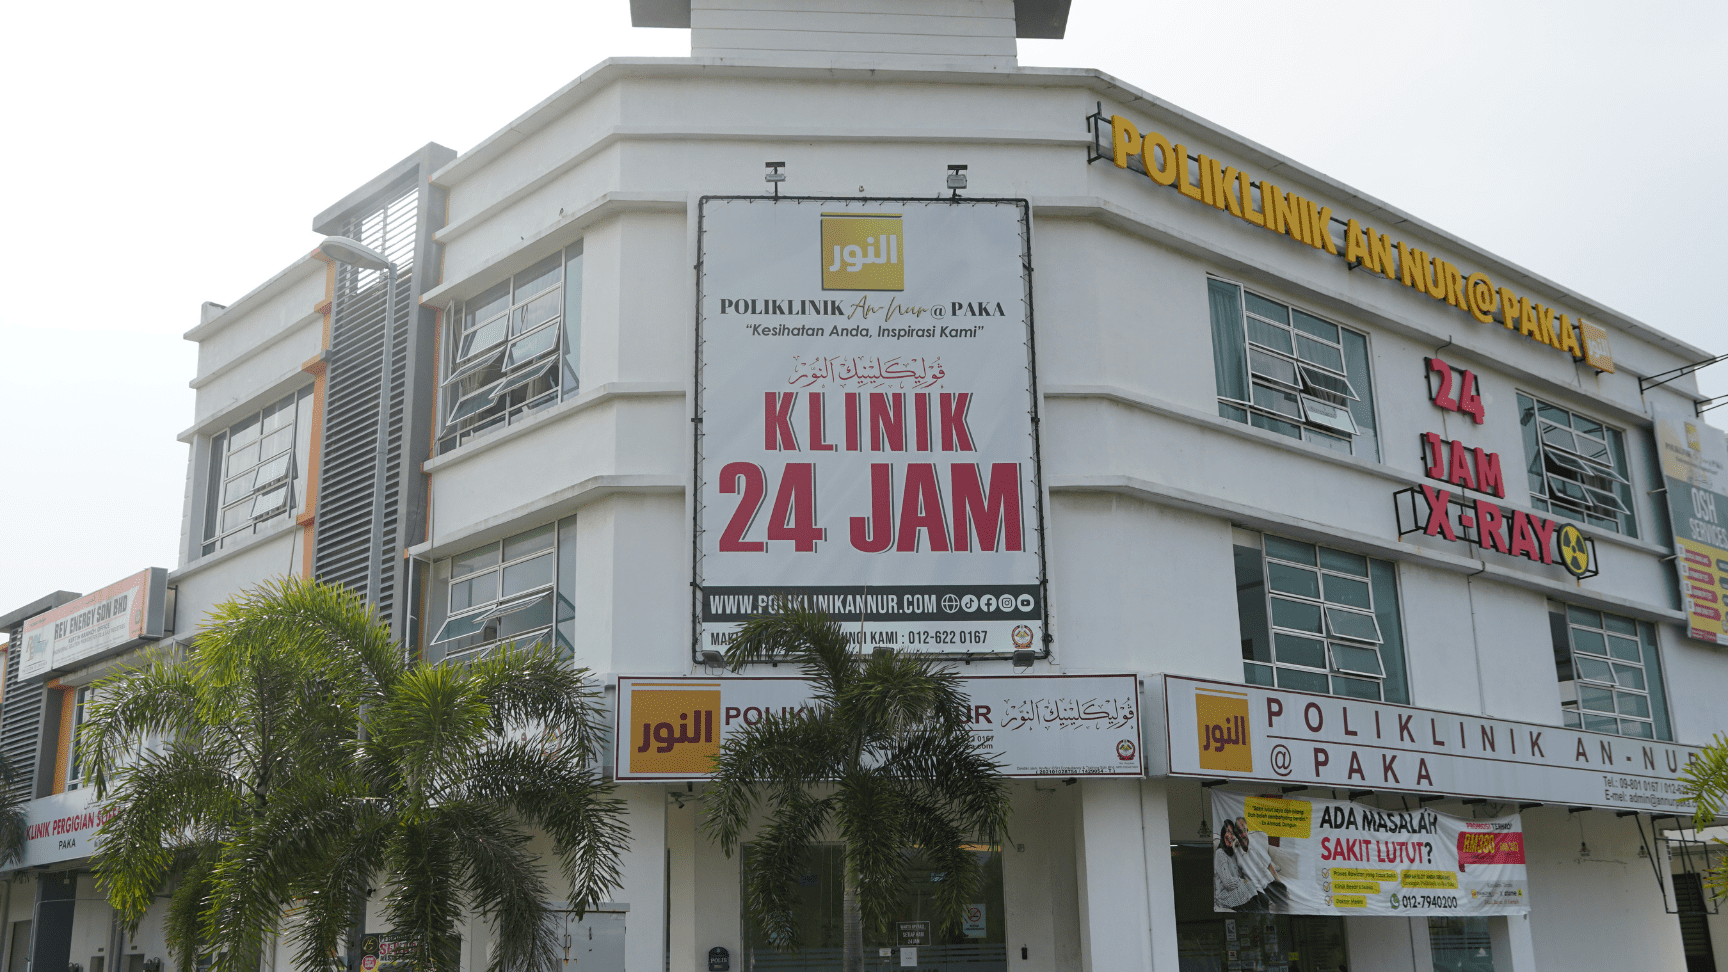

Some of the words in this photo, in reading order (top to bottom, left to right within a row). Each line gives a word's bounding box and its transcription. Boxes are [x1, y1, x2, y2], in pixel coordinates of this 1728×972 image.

[1111, 115, 1338, 256] POLIKLINIK
[1345, 218, 1395, 280] AN
[829, 234, 897, 272] النور
[719, 298, 845, 317] POLIKLINIK
[847, 294, 930, 322] An-Nur
[950, 301, 1006, 317] PAKA
[828, 325, 873, 339] Anda,
[877, 325, 936, 341] Inspirasi
[1429, 358, 1485, 425] 24
[764, 391, 977, 452] KLINIK
[1426, 432, 1505, 499] JAM
[718, 461, 828, 553] 24
[849, 462, 1026, 554] JAM
[1419, 484, 1556, 565] X-RAY
[1691, 487, 1718, 525] OSH
[54, 619, 68, 640] REV
[69, 607, 96, 635] ENERGY
[96, 601, 112, 623] SDN
[113, 595, 128, 616] BHD
[870, 631, 898, 645] KAMI
[908, 630, 956, 645] 012-622
[959, 630, 988, 645] 0167
[637, 709, 713, 754] النور
[1203, 715, 1247, 753] النور
[1266, 697, 1545, 758] POLIKLINIK
[1270, 744, 1293, 777] @
[1313, 747, 1434, 787] PAKA
[1619, 778, 1641, 791] 09-801
[1643, 780, 1659, 792] 0167
[26, 821, 51, 841] KLINIK
[52, 811, 95, 836] PERGIGIAN
[1319, 806, 1359, 831] ADA
[1362, 809, 1437, 835] MASALAH
[58, 838, 76, 850] PAKA
[1321, 836, 1372, 863] SAKIT
[1376, 840, 1433, 865] LUTUT?
[1402, 895, 1458, 909] 012-7940200
